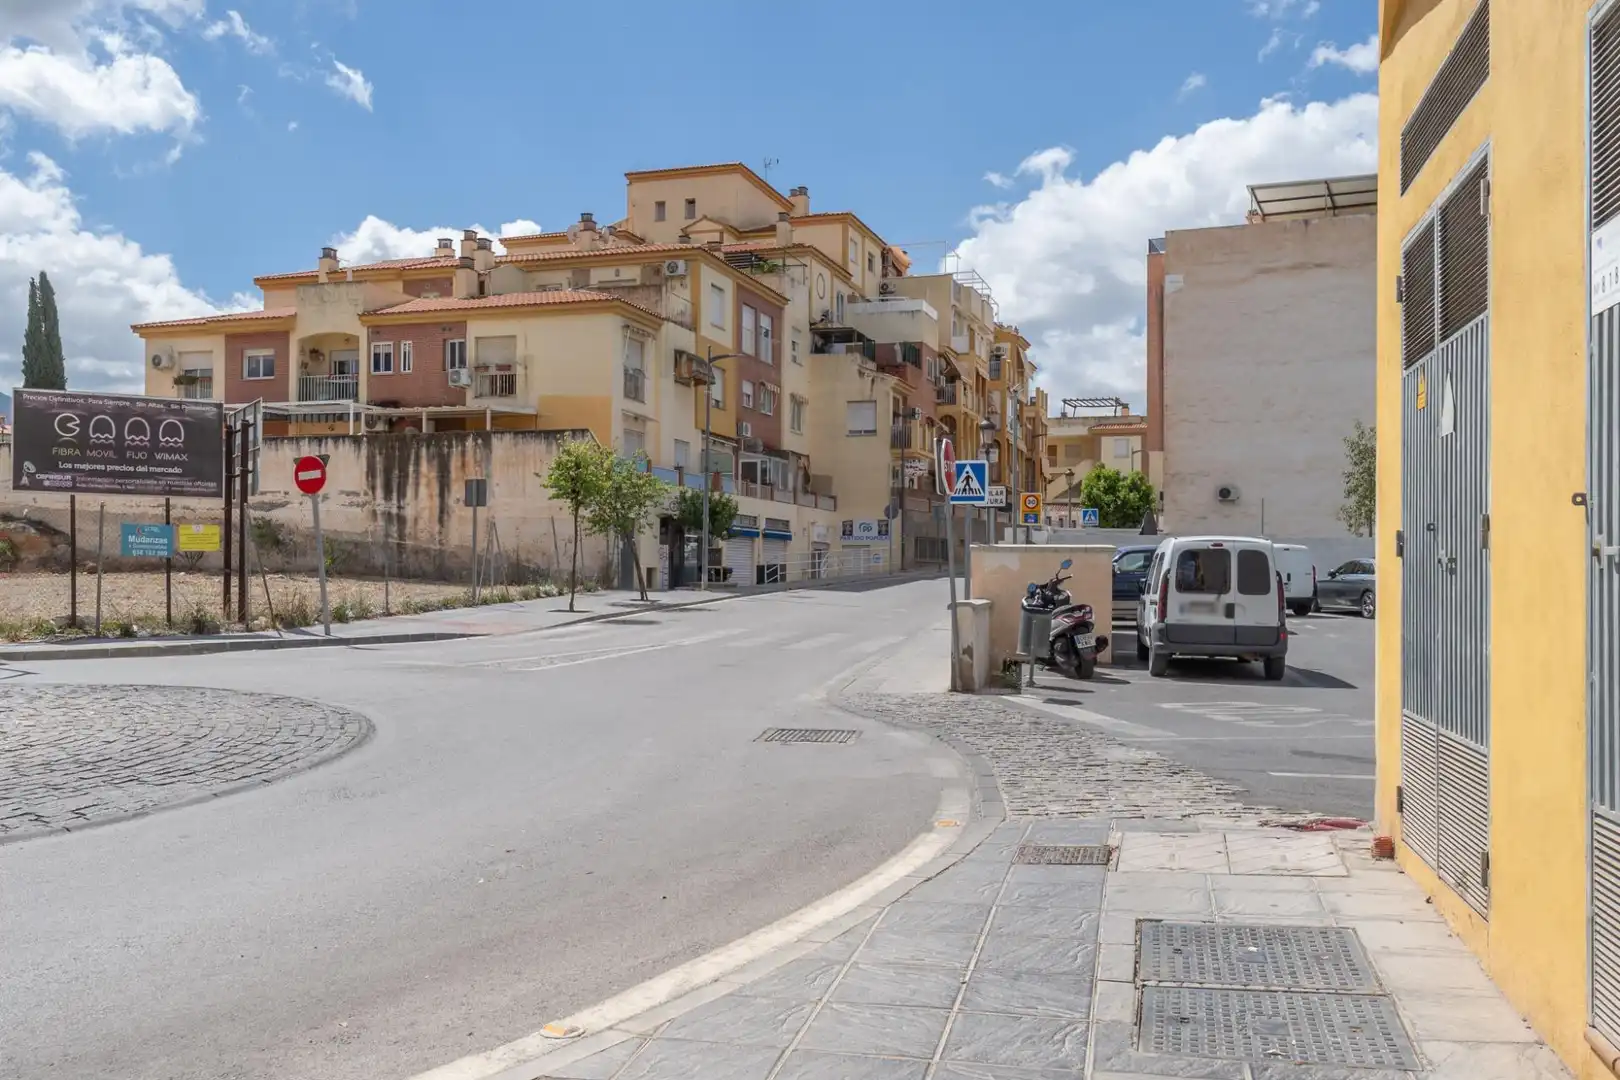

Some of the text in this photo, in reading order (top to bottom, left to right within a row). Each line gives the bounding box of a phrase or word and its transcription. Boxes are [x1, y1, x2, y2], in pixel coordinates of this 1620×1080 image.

[22, 393, 47, 401] Precios
[52, 447, 81, 456] FIBRA
[86, 449, 117, 459] MOVIL
[126, 450, 148, 460] FIJO
[154, 452, 189, 462] WIMAX
[58, 461, 183, 474] Los mejores precios del mercado
[128, 535, 168, 544] Mudanzas
